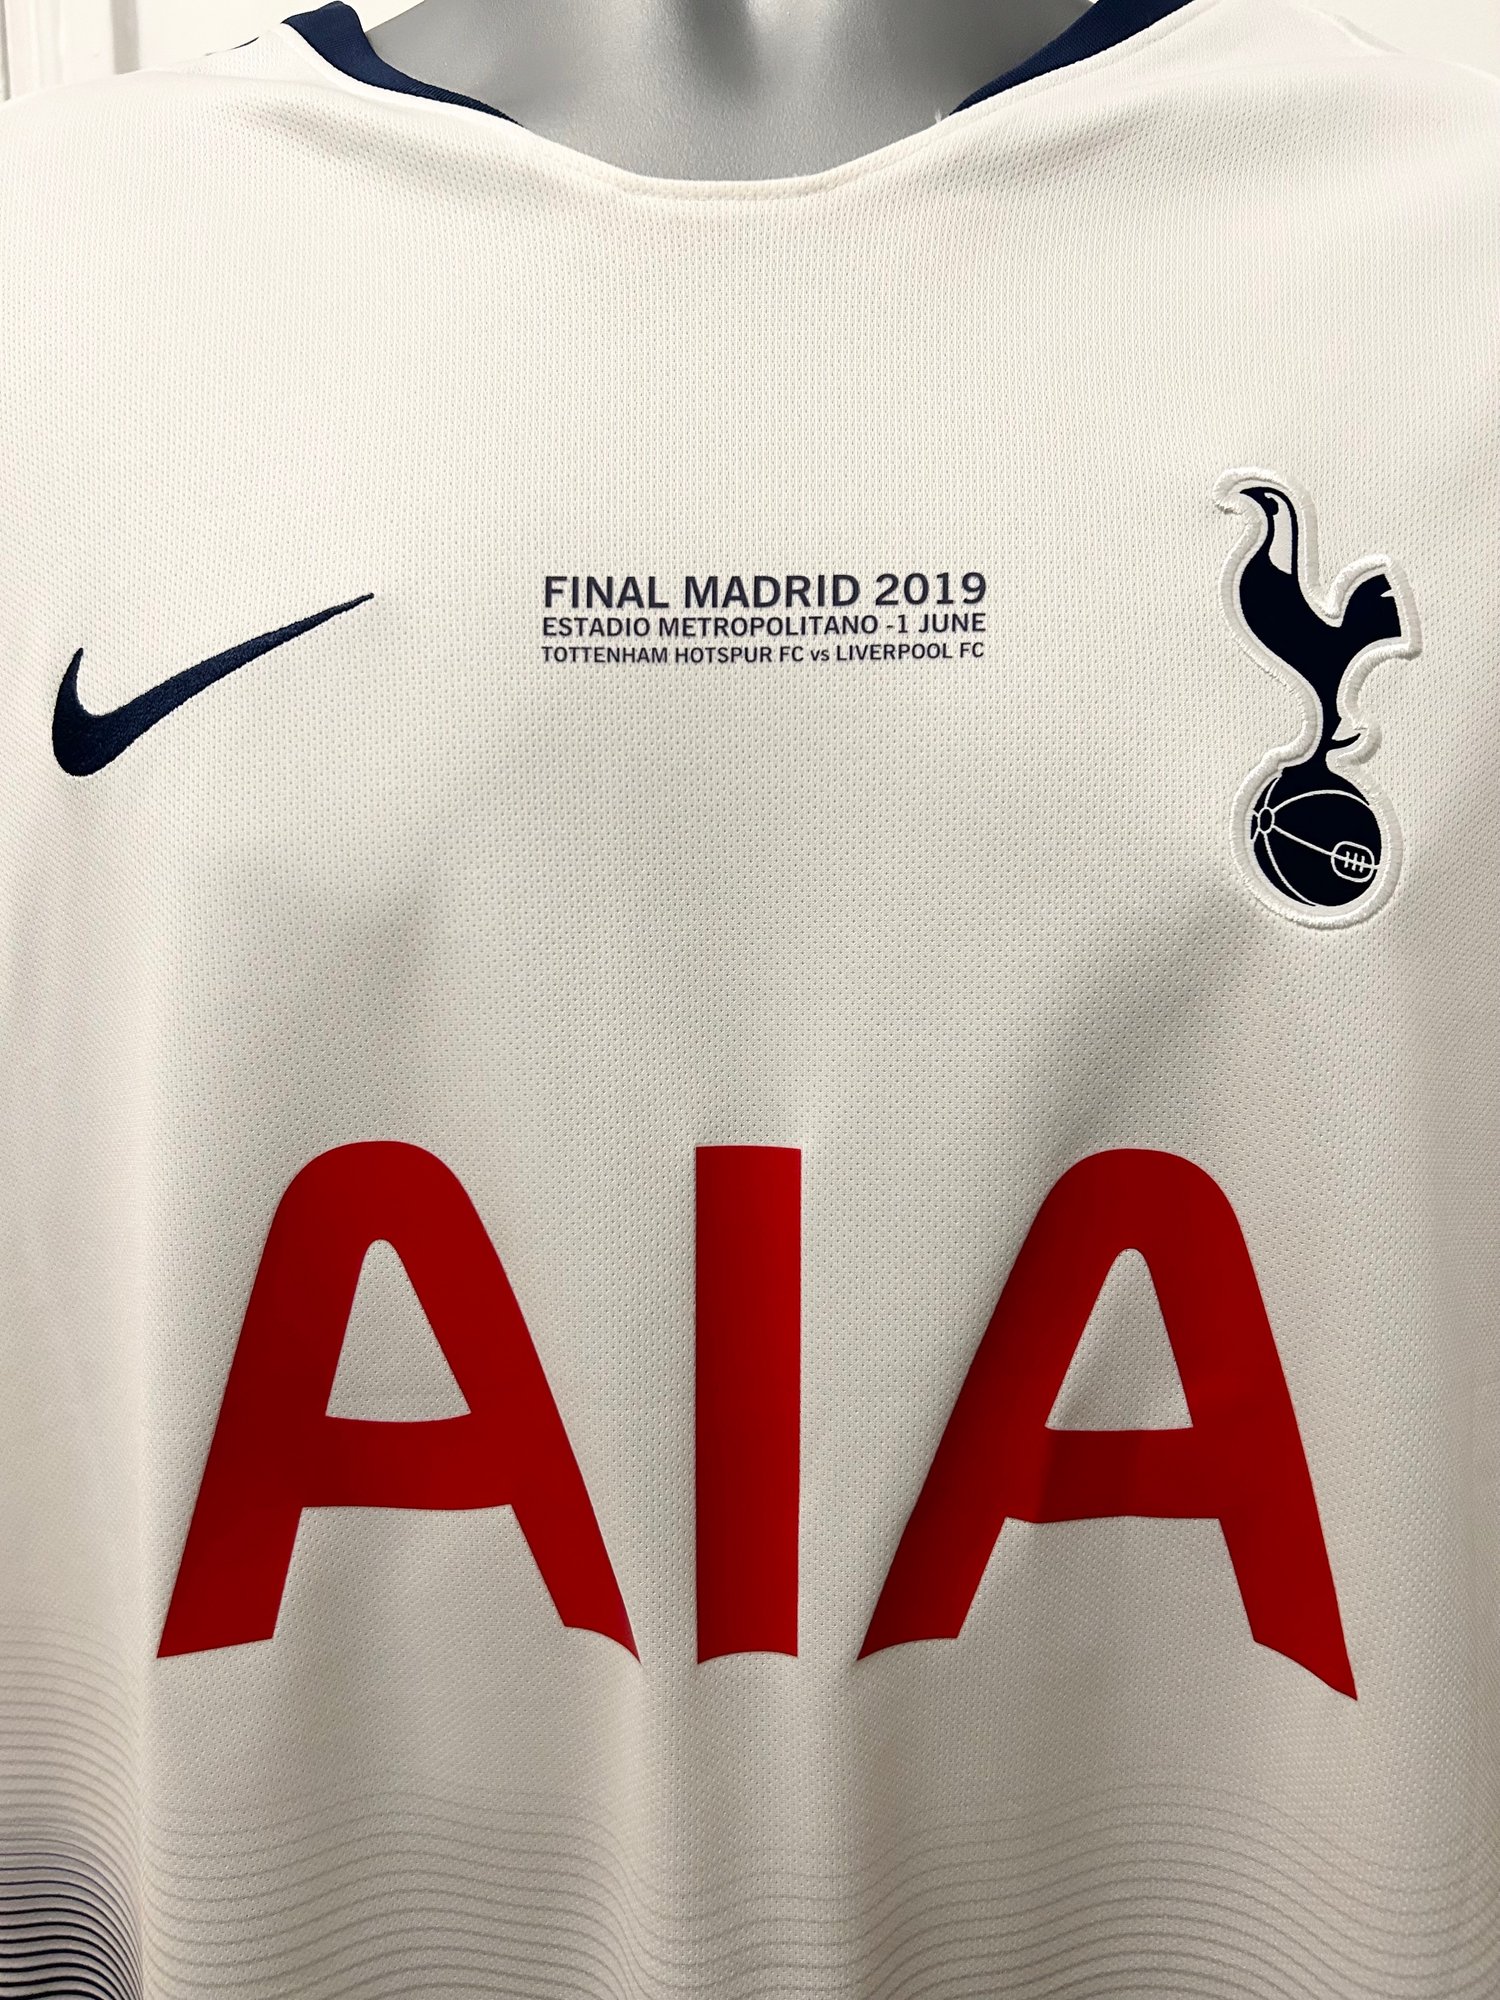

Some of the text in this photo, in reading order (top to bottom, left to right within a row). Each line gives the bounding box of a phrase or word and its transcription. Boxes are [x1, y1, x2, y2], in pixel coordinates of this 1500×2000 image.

[545, 571, 987, 609] FINAL MADRID 2019
[542, 616, 651, 637] ESTADIO
[658, 614, 879, 637] METROPOLITANO
[918, 612, 987, 634] JUNE
[541, 641, 985, 663] TOTTENHAM HOTSPUR FC vs LIVERPOOL FC
[156, 1140, 1358, 1701] AIA
